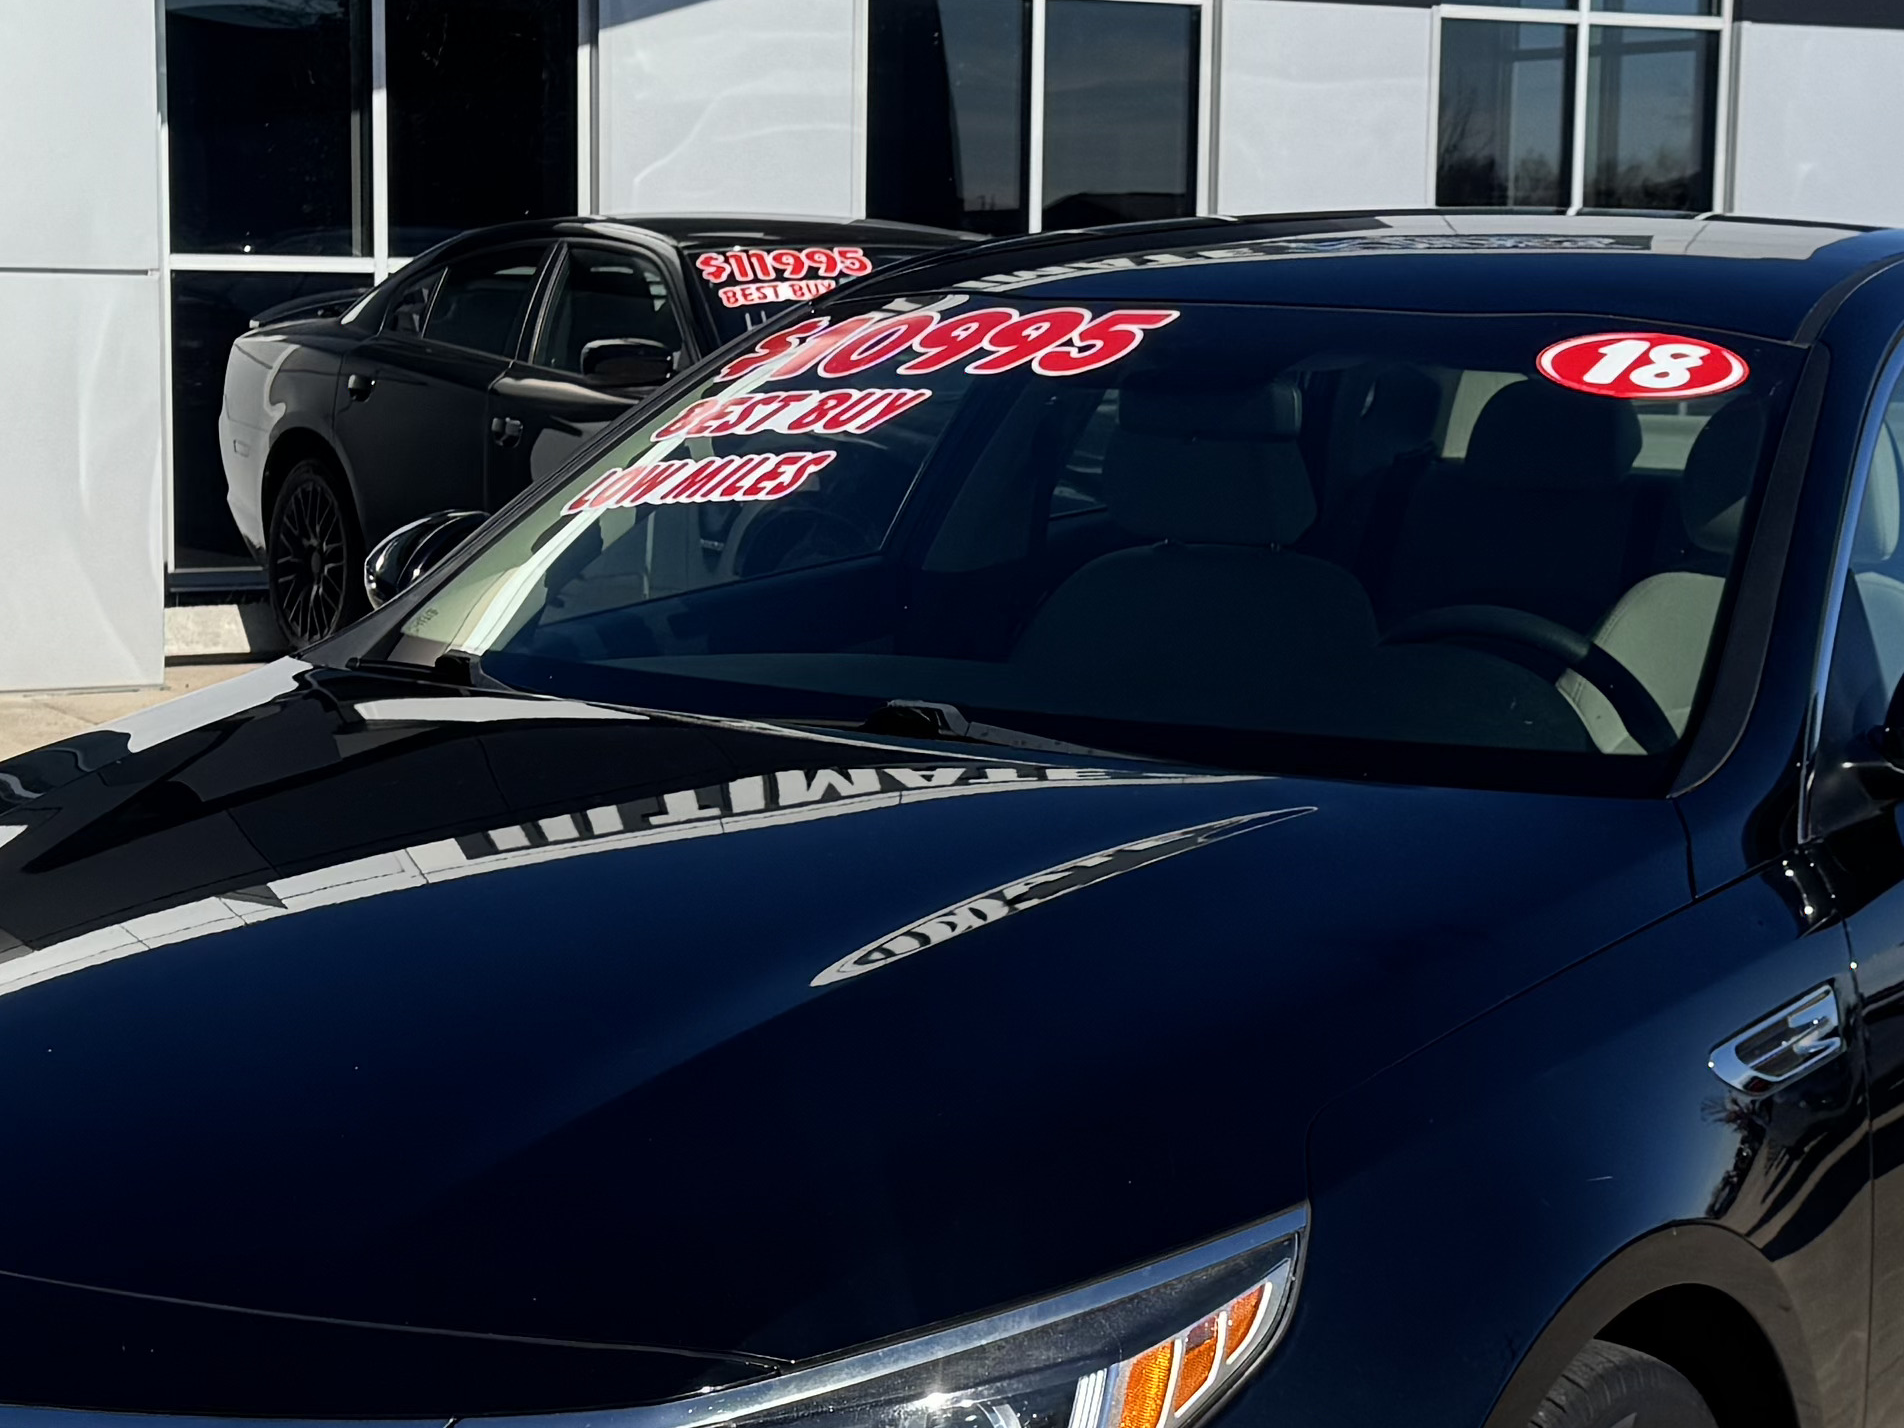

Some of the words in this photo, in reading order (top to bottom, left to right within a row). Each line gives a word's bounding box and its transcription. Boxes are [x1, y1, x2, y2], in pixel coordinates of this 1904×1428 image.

[696, 247, 873, 283] $11995
[718, 283, 782, 308] BEST
[788, 280, 836, 301] BUY
[712, 306, 1182, 383] $10995
[1582, 339, 1712, 389] 18
[649, 389, 820, 443] BEST
[786, 388, 933, 435] BUY
[560, 460, 689, 517] LOW
[659, 450, 837, 504] MILES
